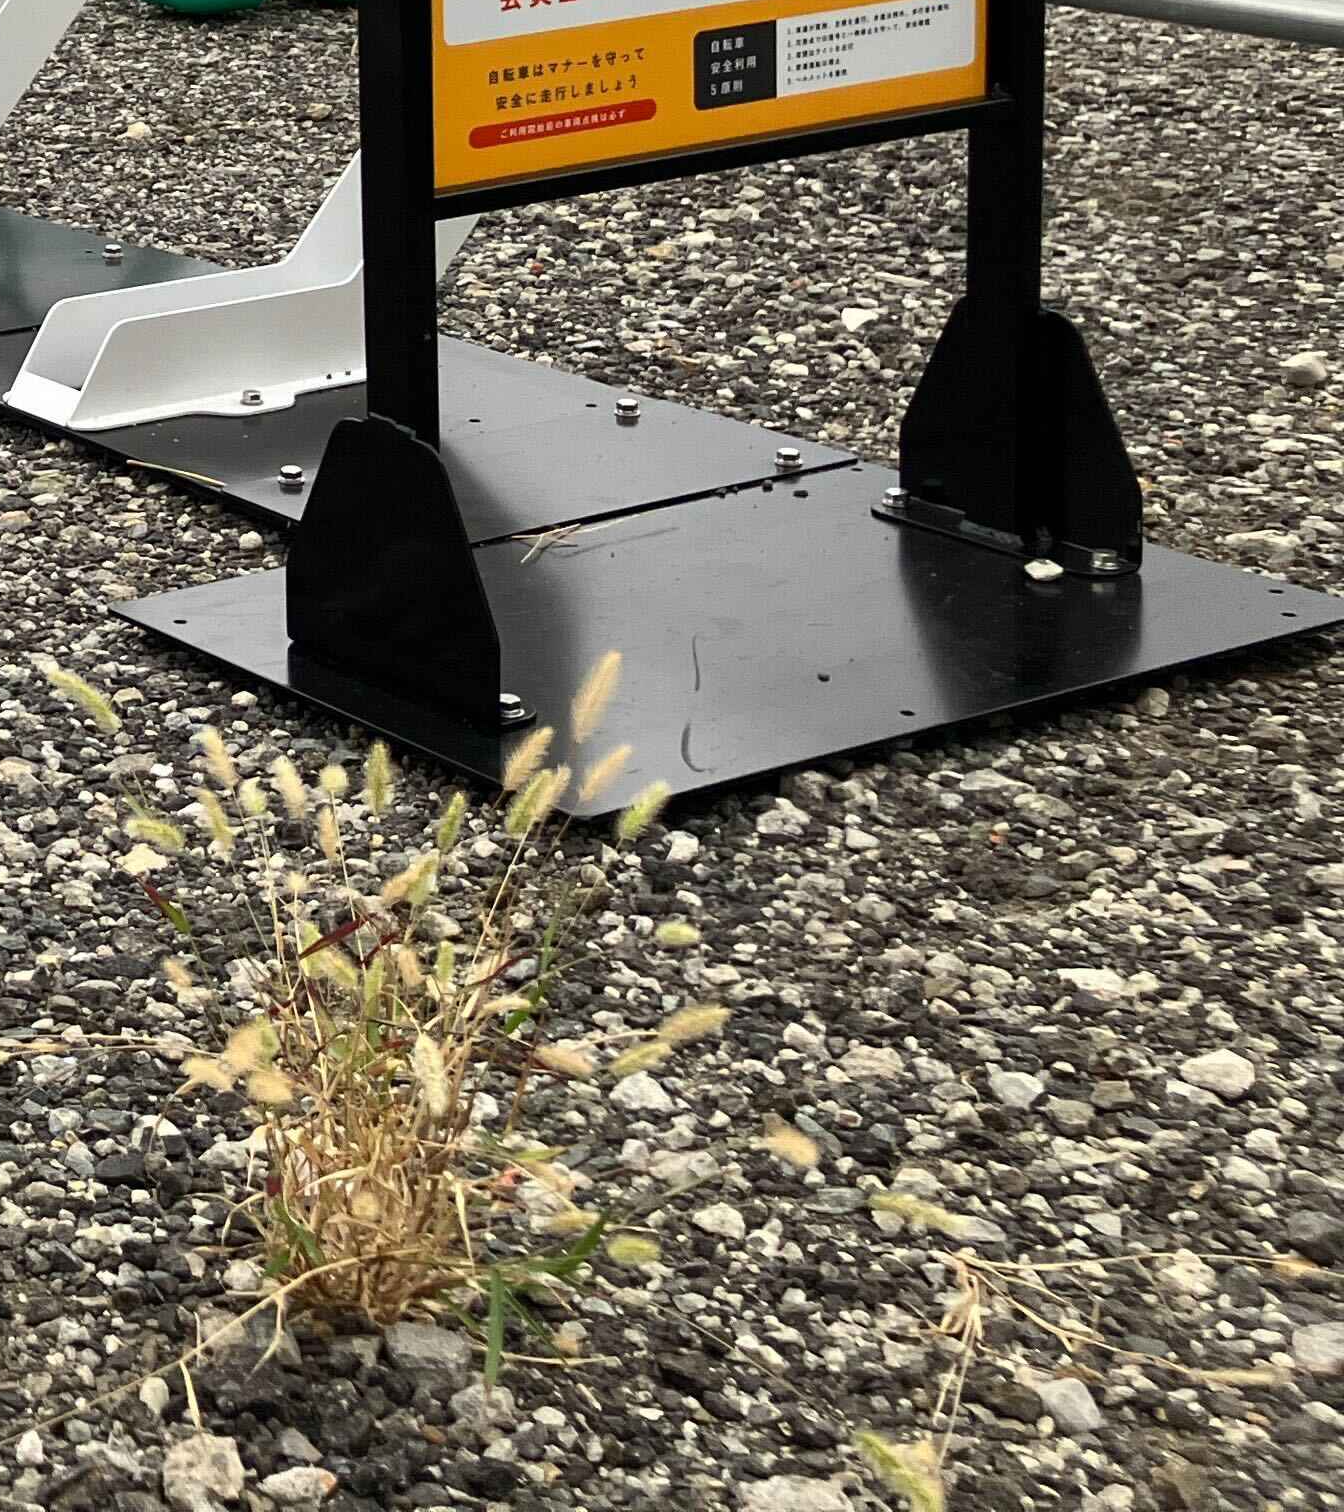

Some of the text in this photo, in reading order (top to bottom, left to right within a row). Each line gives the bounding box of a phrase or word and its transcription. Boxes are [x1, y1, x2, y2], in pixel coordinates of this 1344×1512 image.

[488, 47, 646, 86] 自転車はマナーを守って
[496, 74, 638, 111] 安全に走行しましょう
